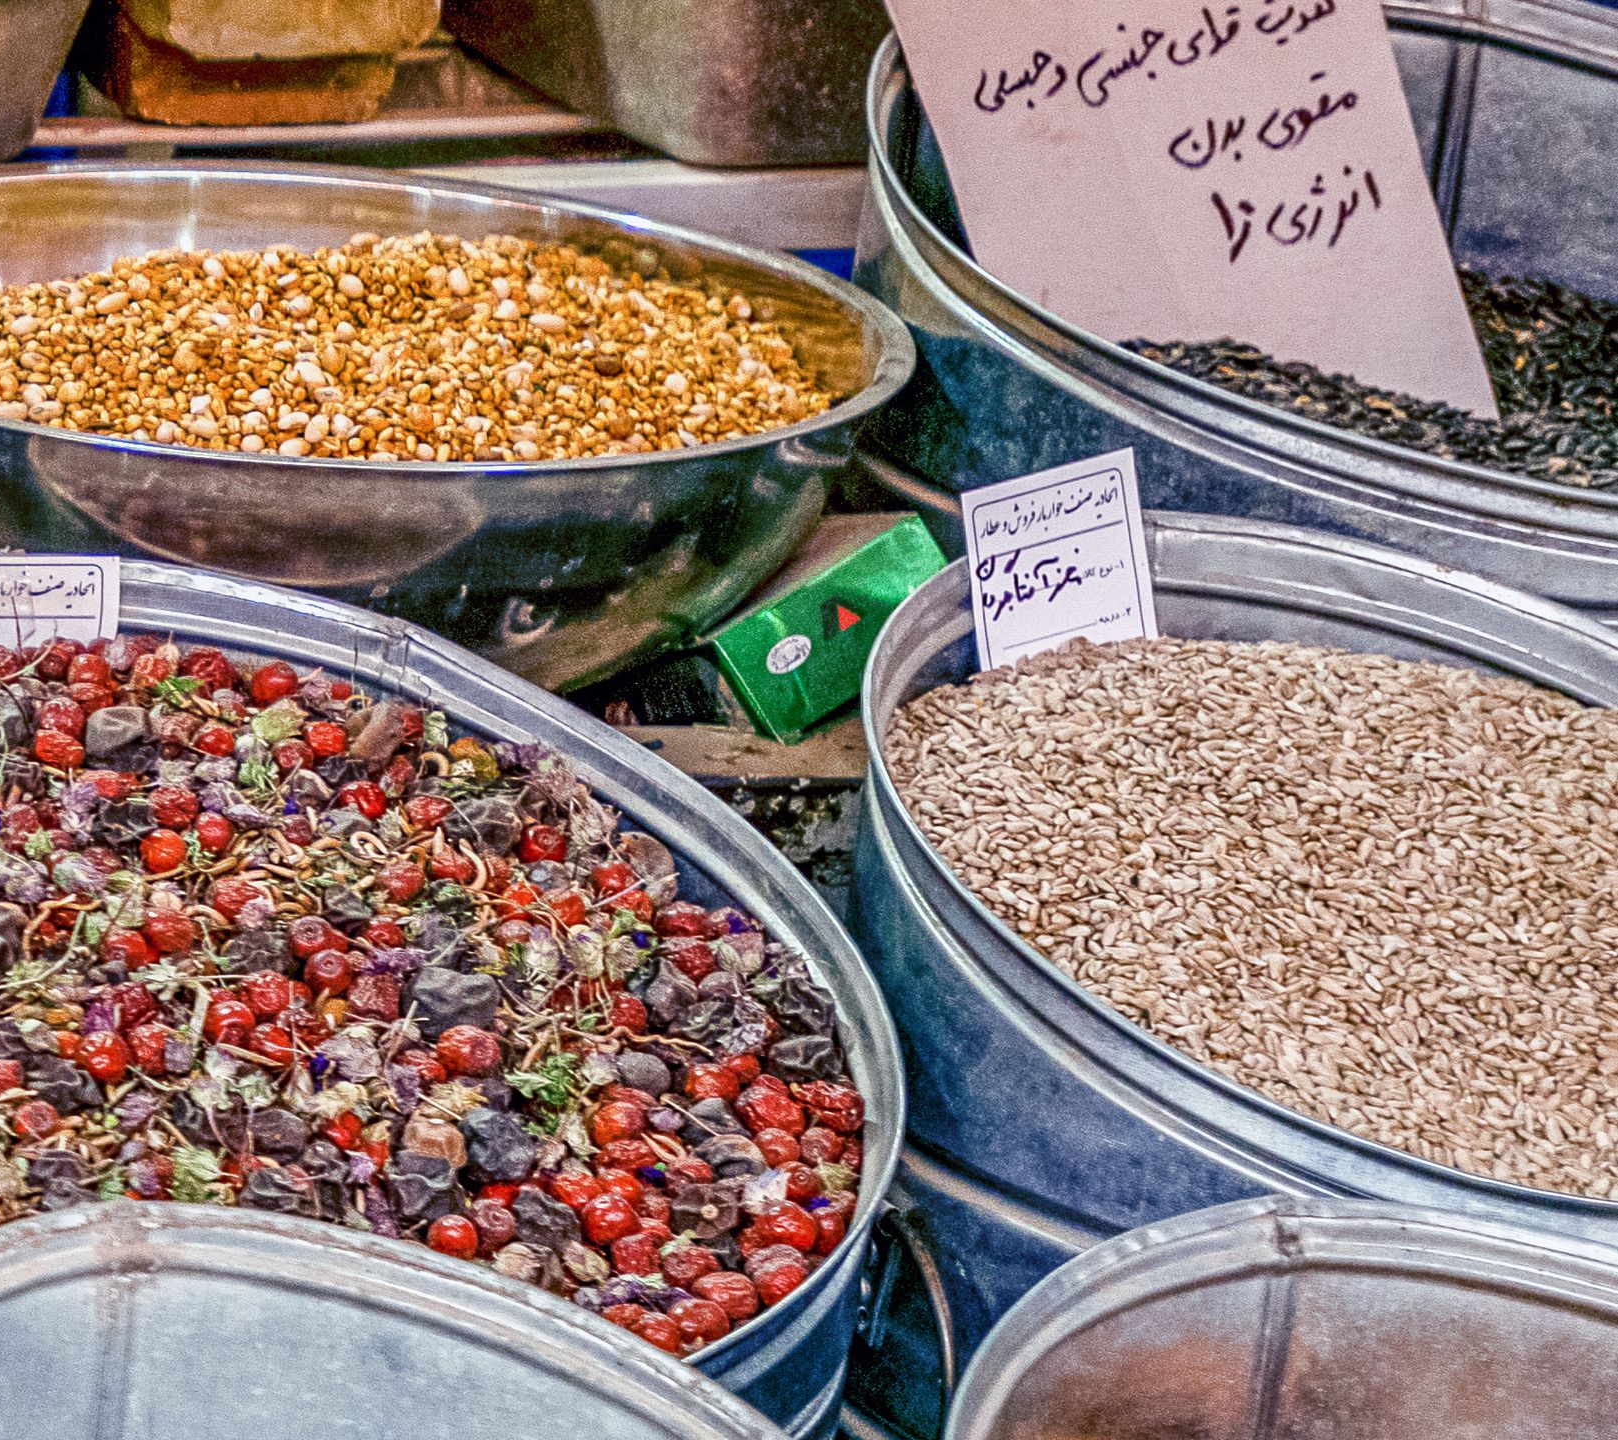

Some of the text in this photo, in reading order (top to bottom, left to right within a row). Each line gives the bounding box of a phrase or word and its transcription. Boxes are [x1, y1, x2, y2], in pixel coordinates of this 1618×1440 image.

[1076, 24, 1165, 108] جنسی
[1168, 71, 1358, 170] مقوی بدن
[1211, 165, 1382, 263] انرژی زا
[1008, 501, 1036, 536] فروش
[1063, 487, 1093, 514] صنف
[1094, 475, 1119, 520] اتحادیه
[980, 519, 1000, 539] عطار
[27, 574, 65, 596] صنف
[64, 570, 96, 609] اتحادیه
[1047, 547, 1083, 603] مغز
